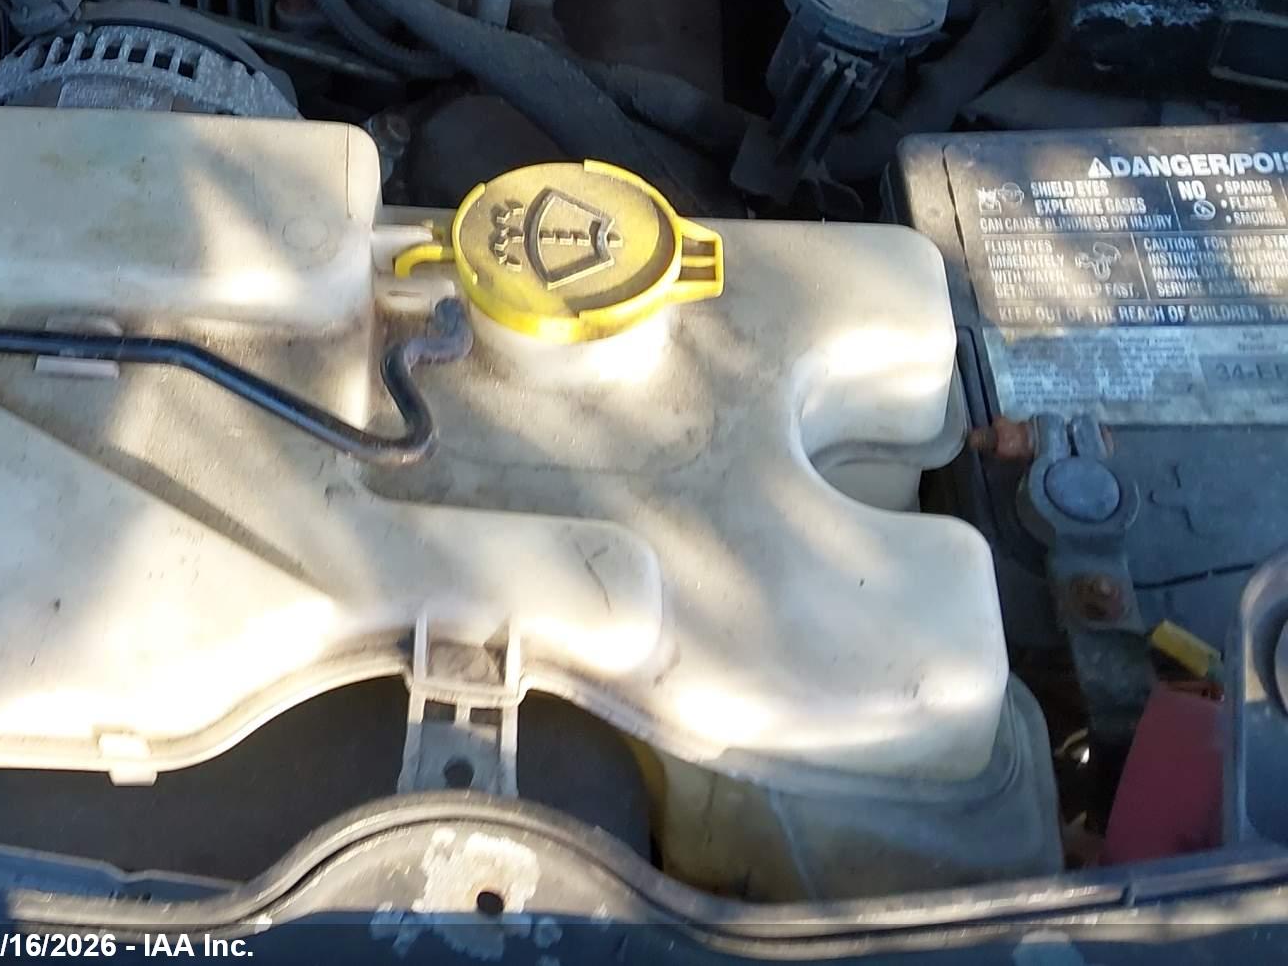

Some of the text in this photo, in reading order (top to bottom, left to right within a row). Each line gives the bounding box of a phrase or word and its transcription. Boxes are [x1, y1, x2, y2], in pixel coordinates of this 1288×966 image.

[1030, 180, 1109, 197] SHIELD EYES
[1177, 180, 1207, 201] NO
[1224, 180, 1272, 195] SPARKS
[1033, 197, 1147, 215] EXPLOSIVE GASES
[1228, 195, 1278, 210] FLAMES
[979, 215, 1173, 234] CAN CAUSE BLINDNESS OR INJURY
[1233, 211, 1286, 226] SMOKING
[984, 239, 1053, 253] FLUSH EYES
[1204, 236, 1228, 250] FOR
[1231, 236, 1261, 249] JUMP
[987, 253, 1064, 268] IMMEDIATELY
[1148, 251, 1231, 266] INSTRUCTIONS
[1233, 250, 1246, 265] IN
[990, 269, 1022, 283] WITH
[1152, 266, 1200, 282] MANUAL
[1200, 266, 1217, 280] OR
[1232, 265, 1257, 280] NOT
[994, 284, 1016, 299] GET
[1018, 283, 1071, 298] MEDICAL
[1073, 283, 1102, 298] HELP
[1156, 282, 1204, 297] SERVICE
[998, 305, 1033, 322] KEEP
[1035, 305, 1062, 323] OUT
[1065, 305, 1083, 321] OF
[1088, 305, 1117, 322] THE
[1118, 305, 1166, 323] REACH
[1168, 305, 1186, 323] OF
